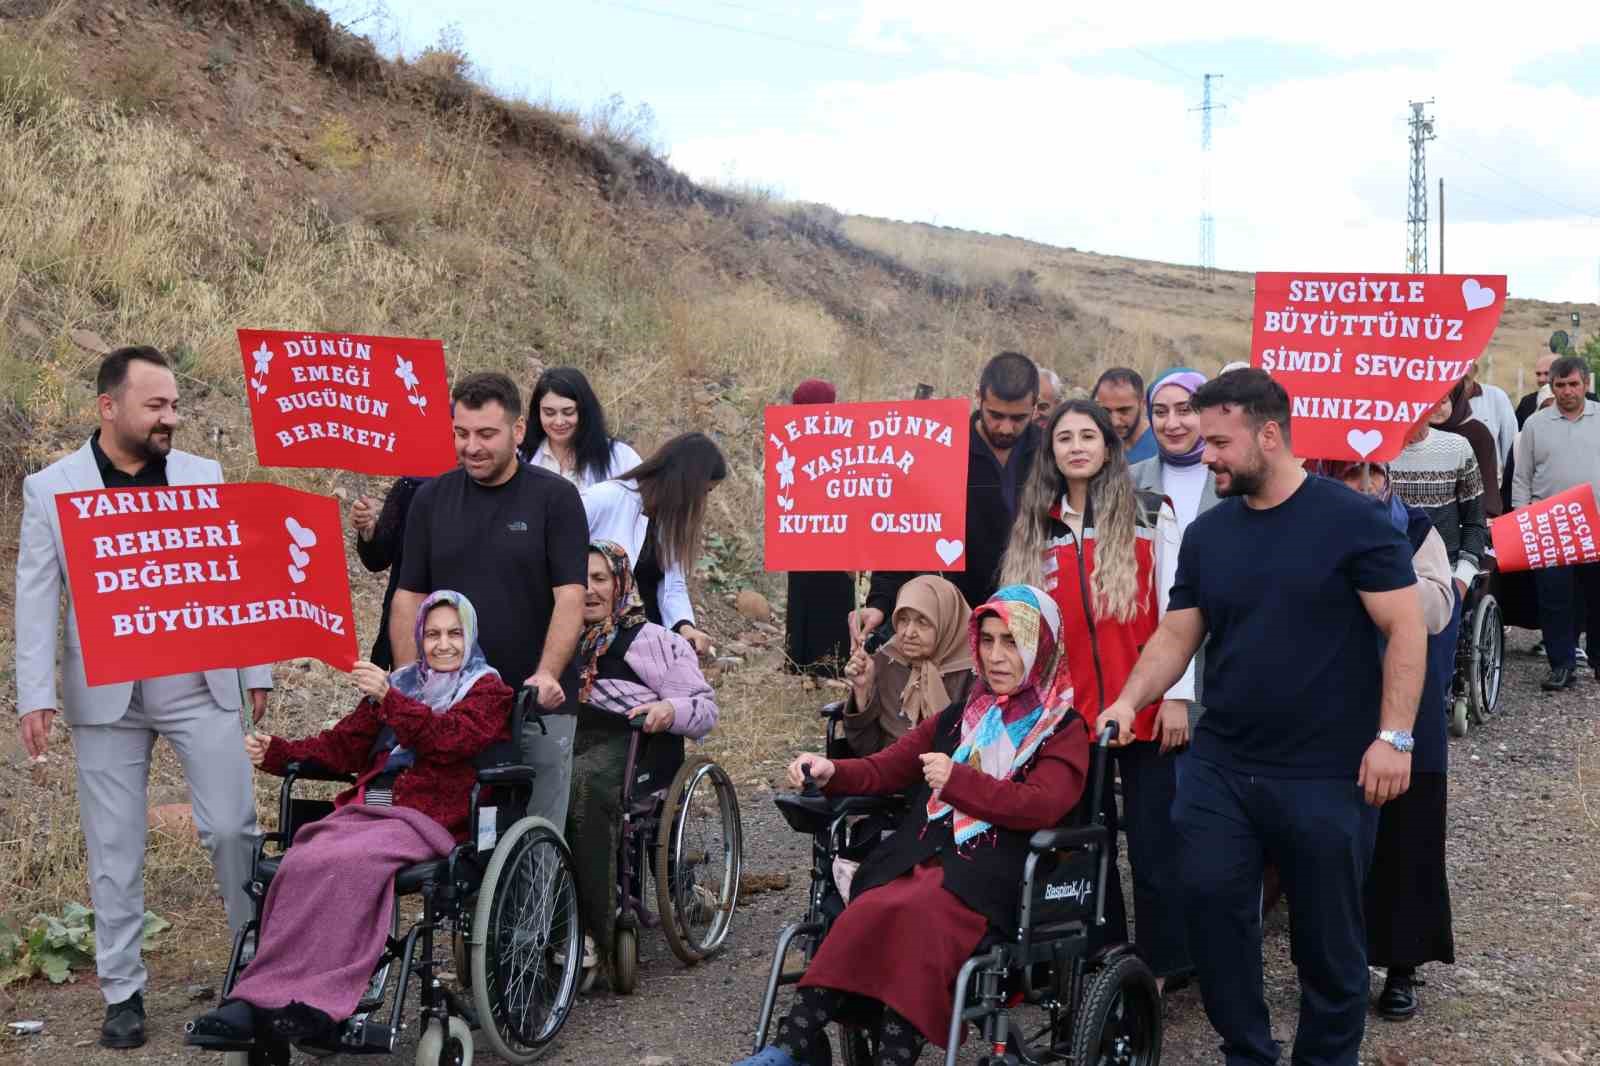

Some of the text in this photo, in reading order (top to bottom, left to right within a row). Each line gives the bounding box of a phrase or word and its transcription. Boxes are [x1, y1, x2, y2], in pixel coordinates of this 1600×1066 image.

[1288, 277, 1425, 303] SEVGİYLE
[1263, 306, 1463, 341] BÜYÜTTÜNÜZ
[283, 338, 372, 361] DÜNÜN
[1261, 346, 1343, 375] ŞİMDİ
[291, 365, 370, 387] EMEĞİ
[276, 391, 389, 418] BUGÜNÜN
[276, 422, 397, 452] BEREKETİ
[769, 411, 953, 450] 1 EKİM DÜNYA
[801, 445, 915, 481] YAŞLILAR
[826, 470, 893, 498] GÜNÜ
[70, 487, 220, 519] YARININ
[778, 512, 942, 534] KUTLU OLSUN
[93, 519, 241, 559] REHBERİ
[94, 554, 241, 594] DEĞERLİ
[112, 592, 345, 637] BÜYÜKLERİMİZ
